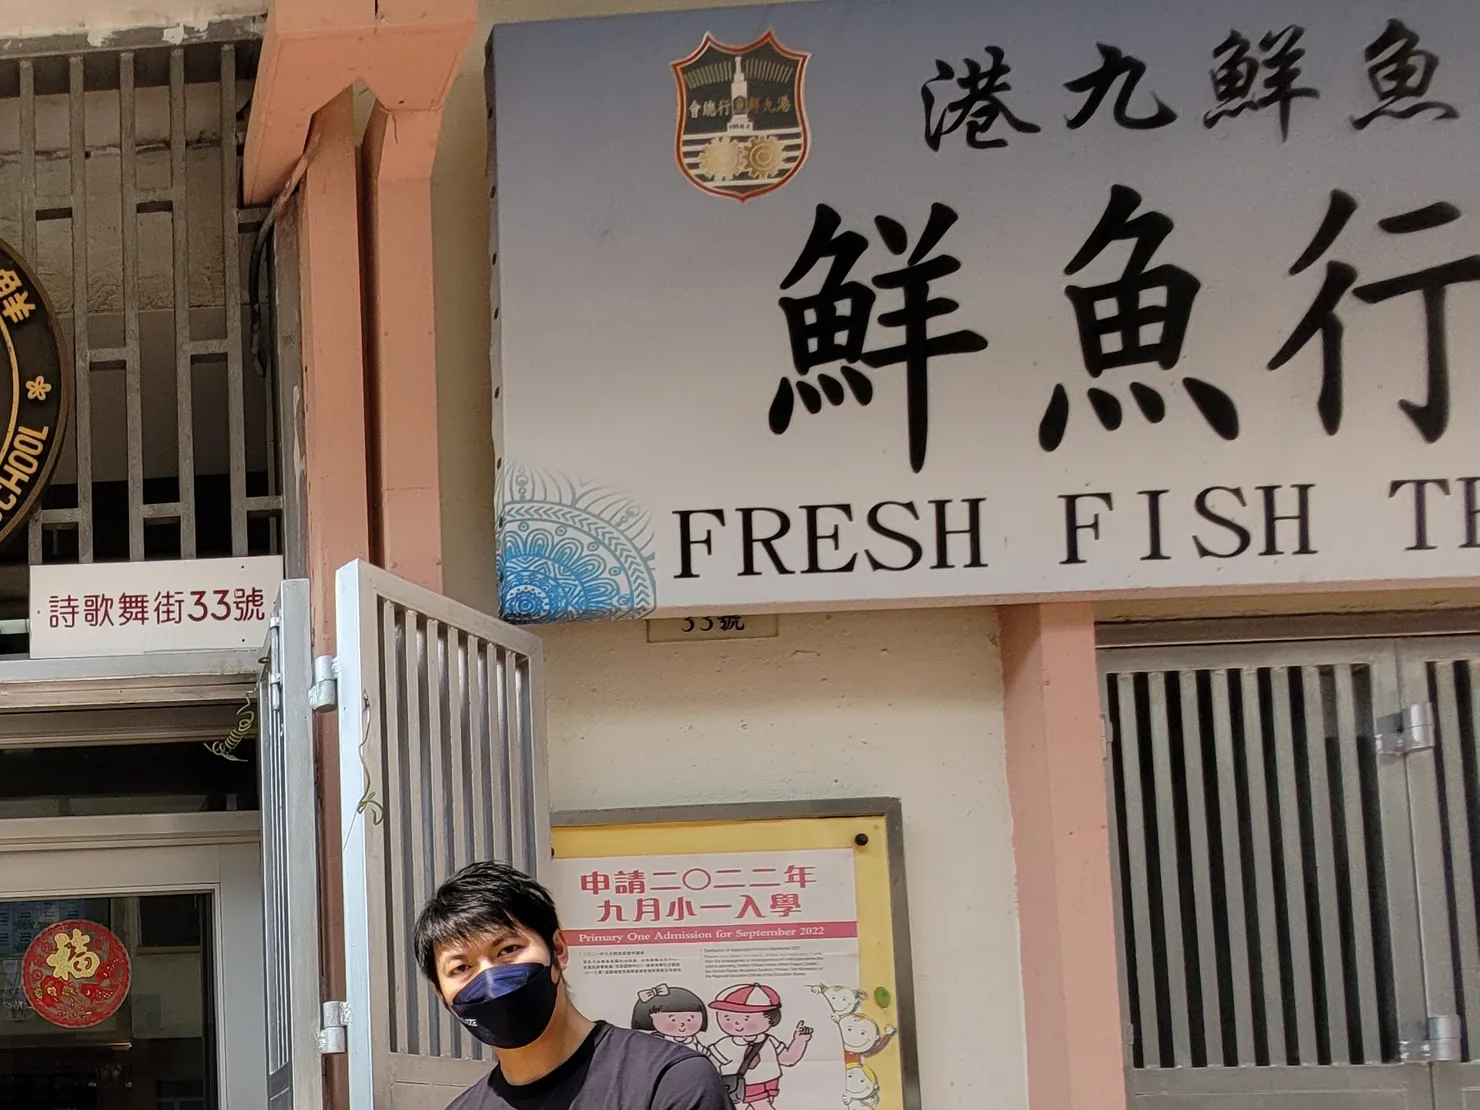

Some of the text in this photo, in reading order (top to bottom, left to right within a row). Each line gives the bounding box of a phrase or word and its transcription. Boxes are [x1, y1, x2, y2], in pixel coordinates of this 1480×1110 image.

[920, 18, 1461, 152] 港九鮮魚
[767, 184, 1480, 474] 鮮魚行
[672, 497, 987, 579] FRESH
[1058, 483, 1319, 566] FISH
[48, 586, 266, 628] 詩歌舞街33號
[597, 893, 803, 923] 九月小一入學
[46, 928, 100, 981] 福
[578, 926, 825, 944] Primary One Admission for September 2022
